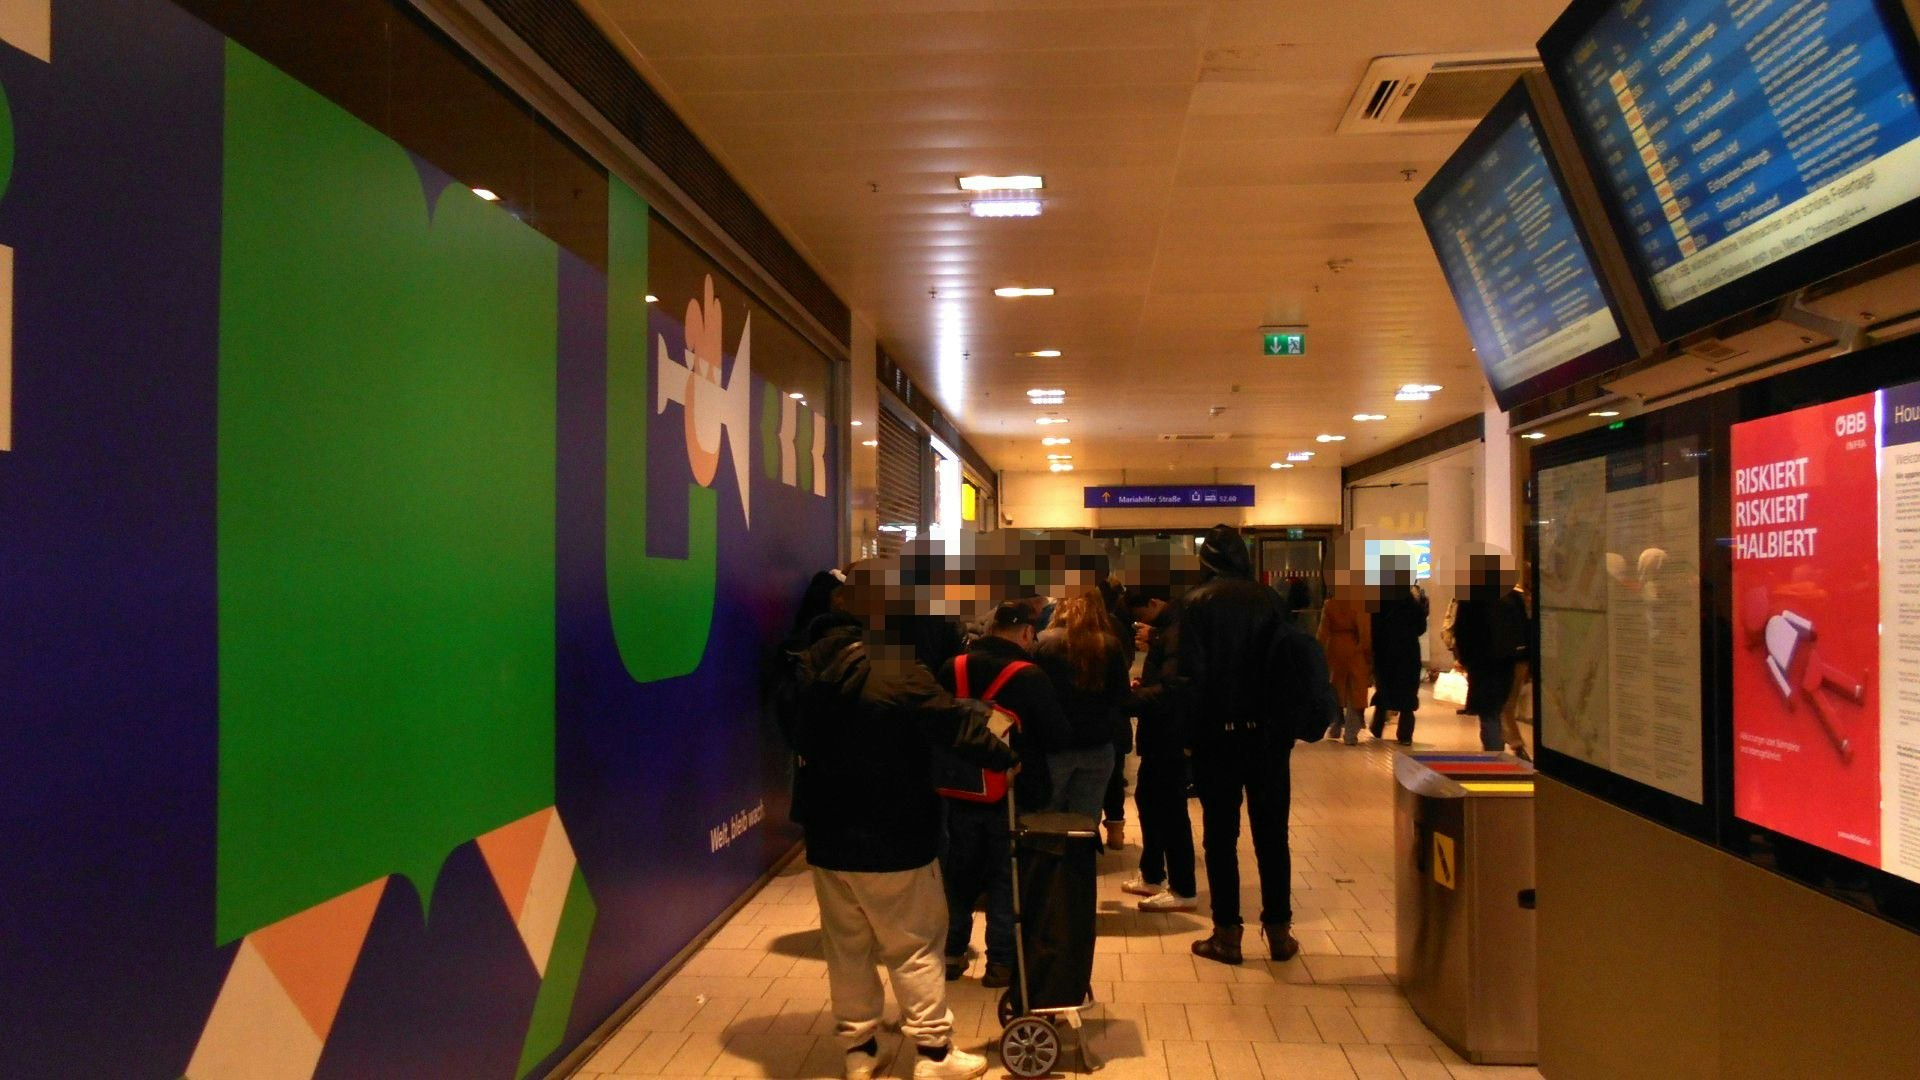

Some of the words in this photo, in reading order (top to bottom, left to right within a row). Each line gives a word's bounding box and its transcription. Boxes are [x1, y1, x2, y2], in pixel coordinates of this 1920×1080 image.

[1835, 411, 1867, 437] ÖBB
[1894, 402, 1920, 424] Hou
[1735, 457, 1809, 496] RISKIERT
[1118, 495, 1157, 504] Mariahilfer
[1158, 495, 1182, 504] Straße
[1735, 492, 1809, 528] RISKIERT
[1736, 527, 1818, 560] HALBIERT
[710, 821, 730, 853] Welt,
[730, 809, 748, 840] bleib
